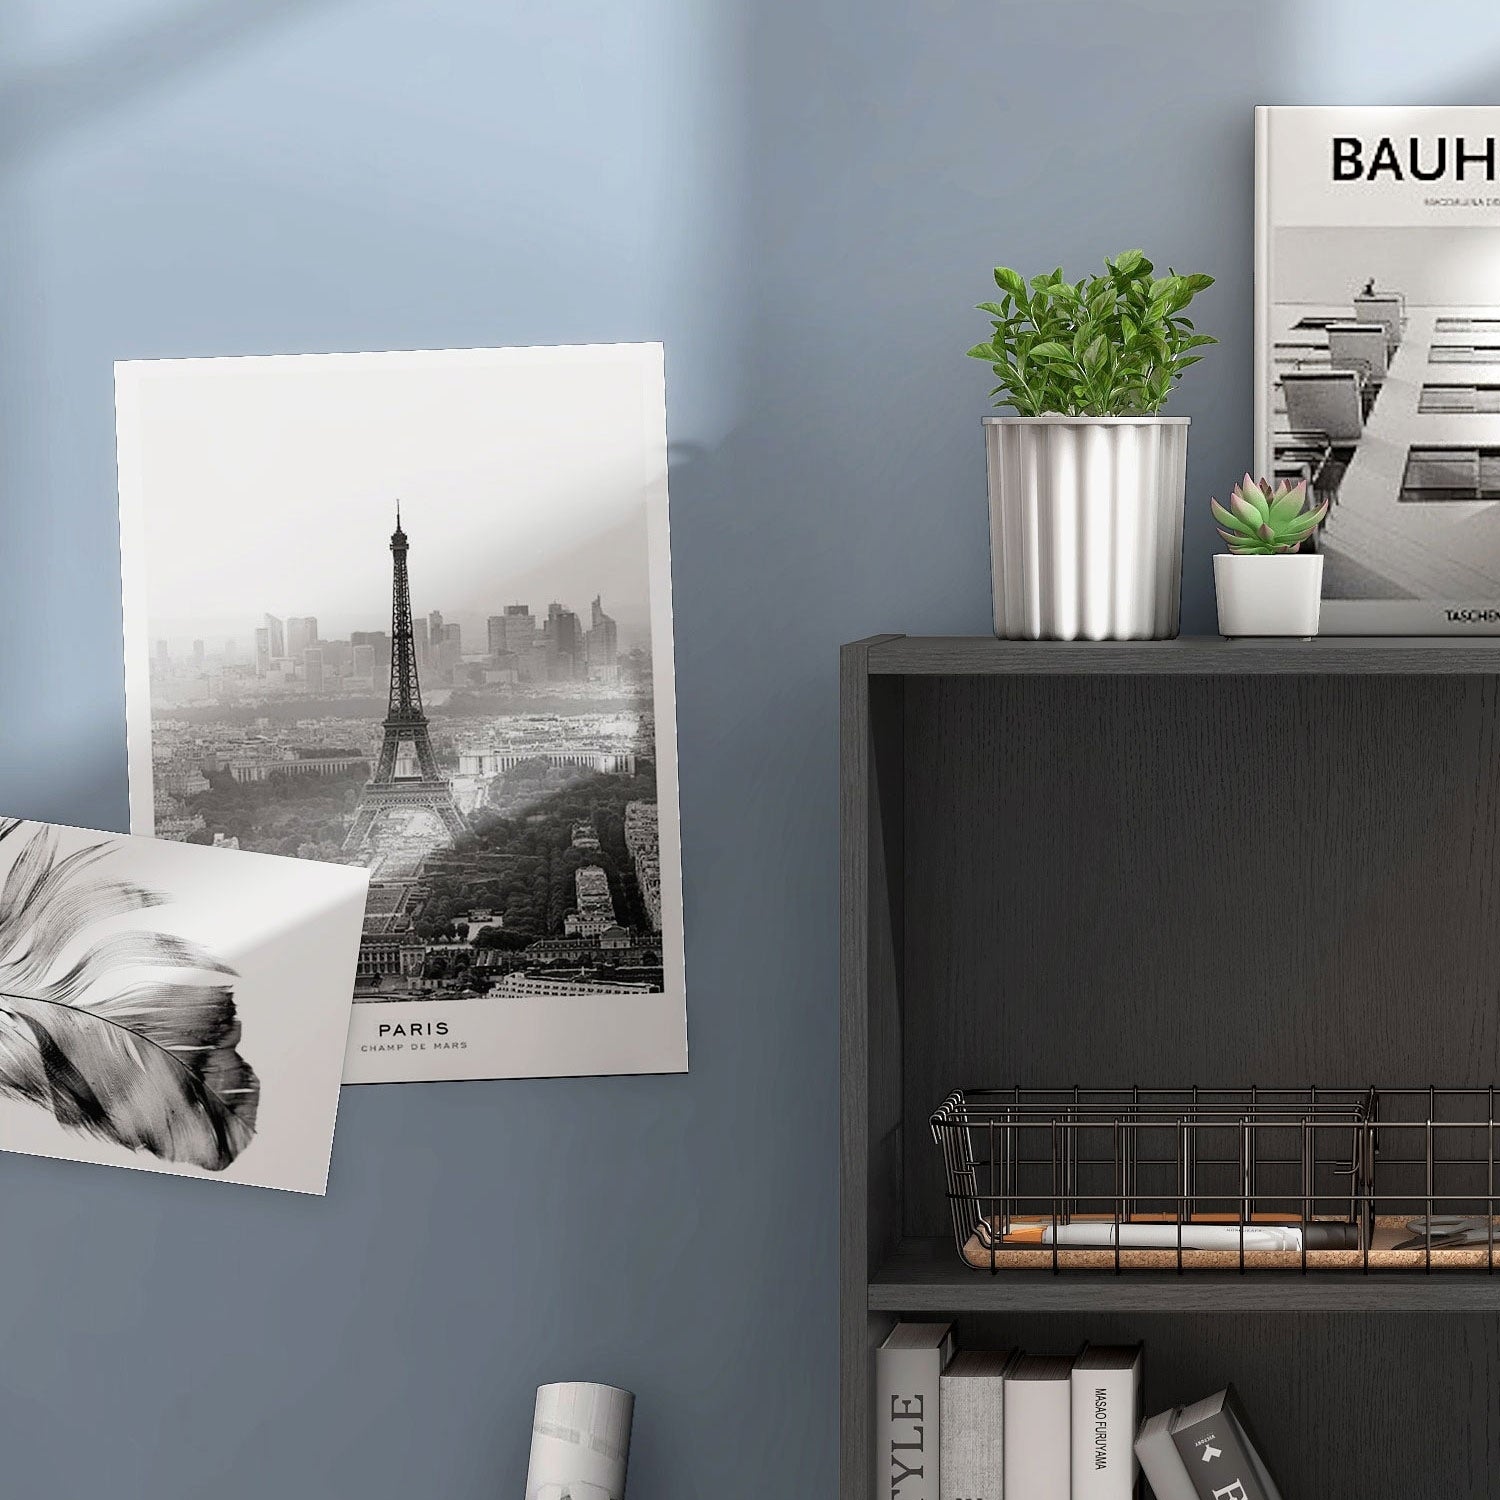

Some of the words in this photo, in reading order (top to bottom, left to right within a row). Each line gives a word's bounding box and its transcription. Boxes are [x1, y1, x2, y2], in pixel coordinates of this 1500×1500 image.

[379, 1022, 449, 1037] PARIS
[361, 1044, 404, 1052] CHAMP
[433, 1041, 467, 1049] MARS
[1095, 1388, 1107, 1420] MASAO
[1095, 1421, 1107, 1471] FURUYAMA
